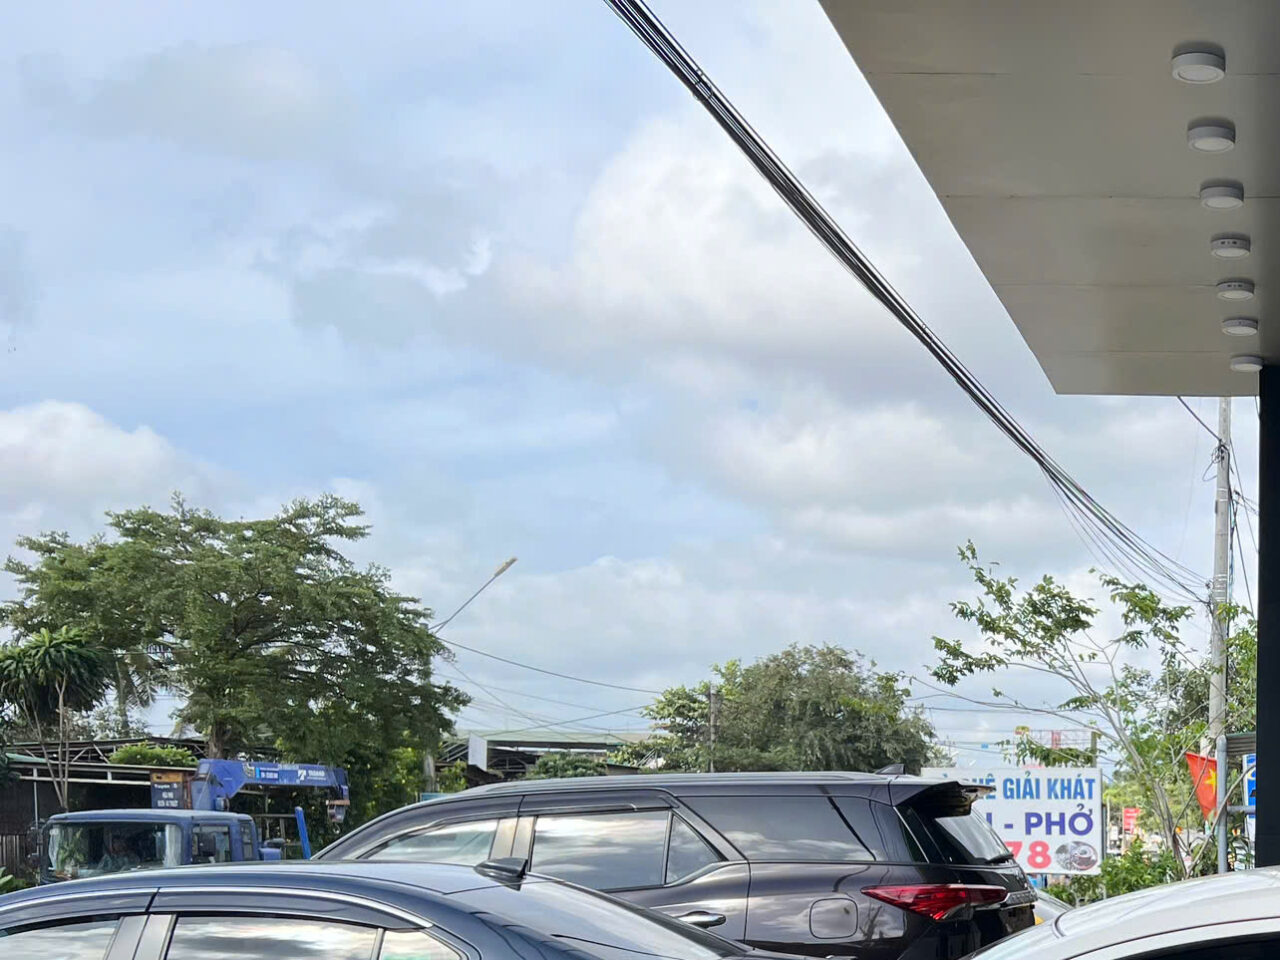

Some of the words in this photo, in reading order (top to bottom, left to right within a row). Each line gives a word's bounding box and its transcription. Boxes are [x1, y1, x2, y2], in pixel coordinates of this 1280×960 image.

[1003, 771, 1041, 800] GIẢI
[1047, 774, 1096, 800] KHÁT
[1025, 803, 1094, 836] PHỞ
